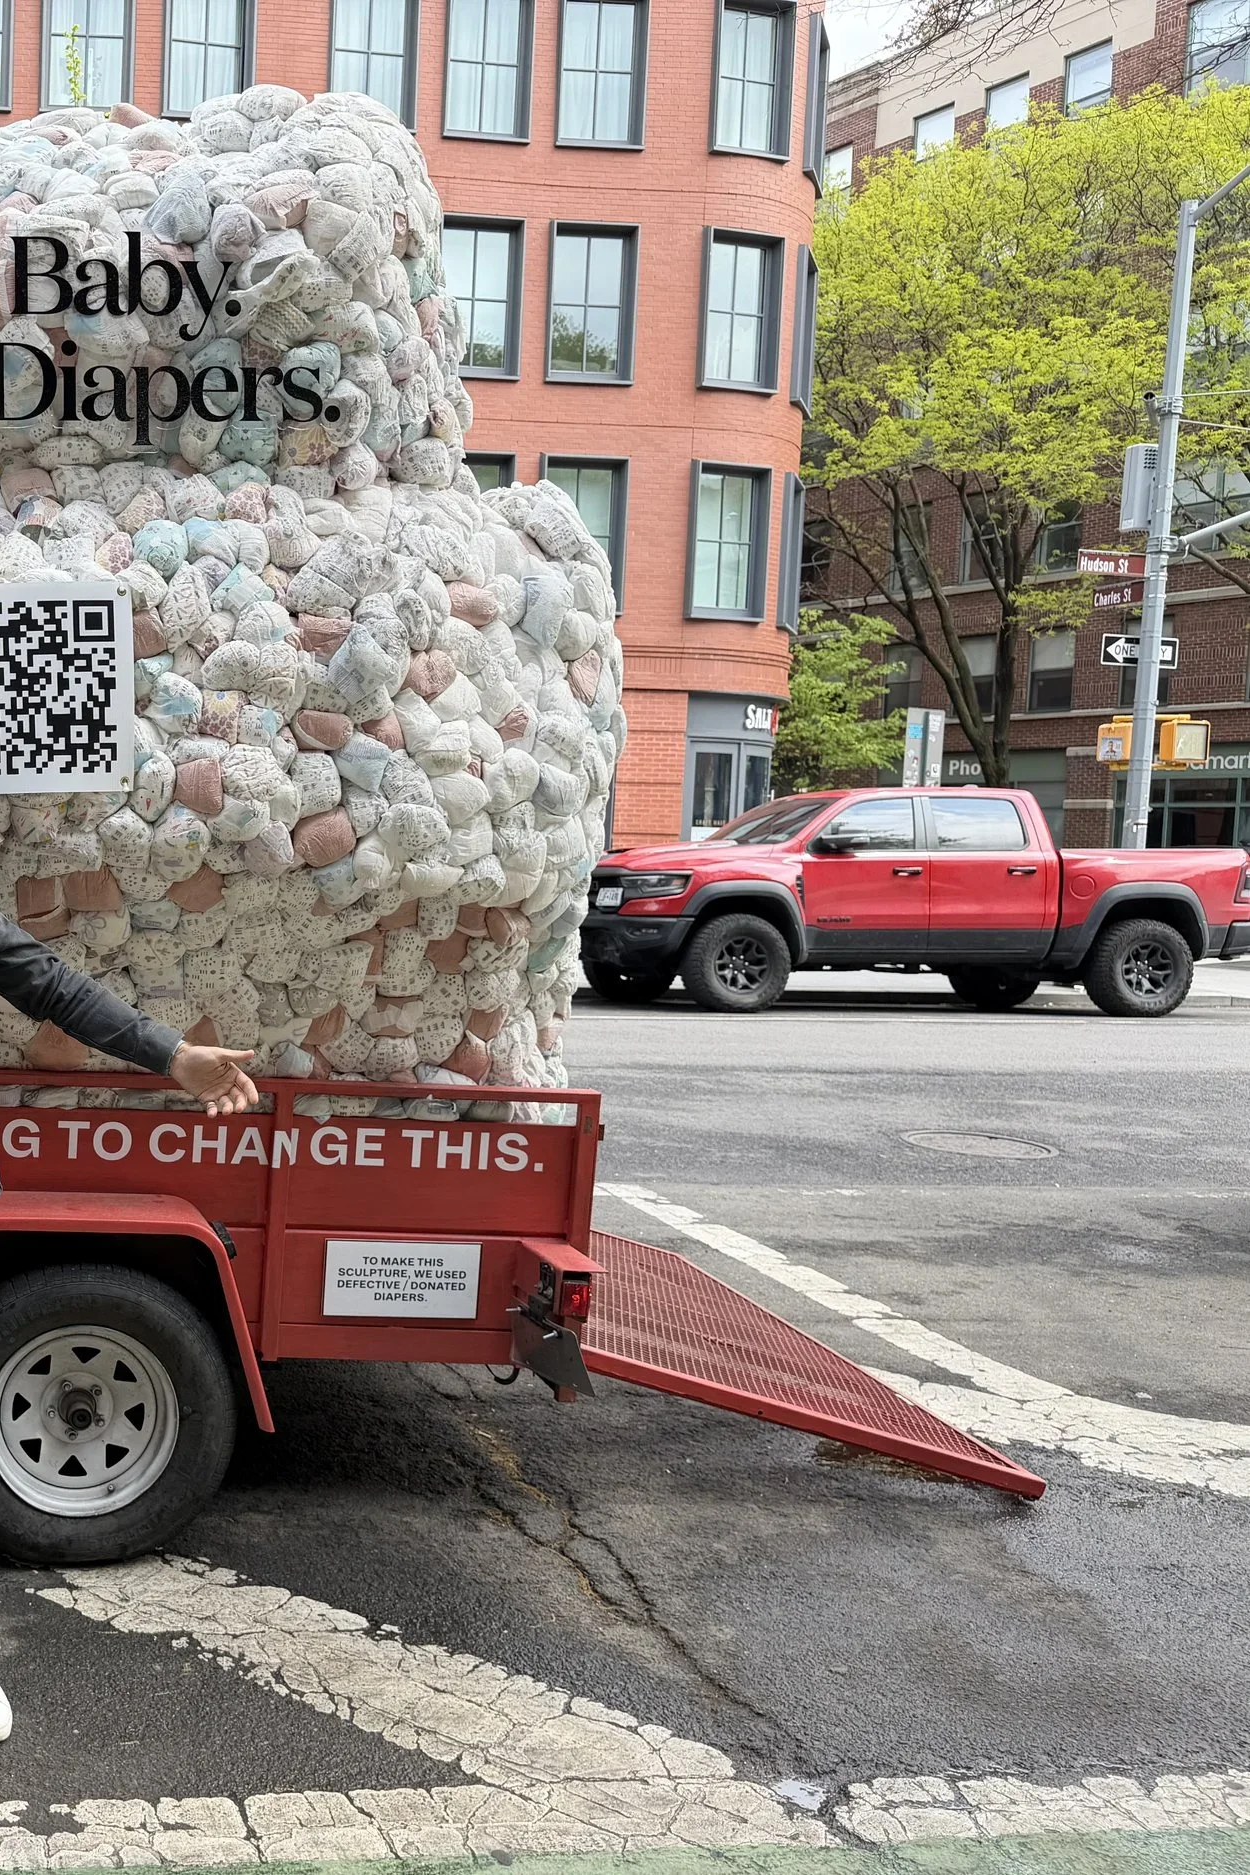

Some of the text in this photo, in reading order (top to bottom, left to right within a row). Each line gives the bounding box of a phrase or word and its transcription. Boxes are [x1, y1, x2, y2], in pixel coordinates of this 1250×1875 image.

[10, 230, 242, 341] Baby.
[1080, 556, 1129, 574] Hudson St
[1094, 588, 1132, 607] Charles St
[1114, 645, 1136, 657] ONE
[58, 1120, 133, 1162] TO
[149, 1122, 385, 1169] CHANGE
[401, 1129, 545, 1172] THIS.
[362, 1256, 444, 1267] TO MAKE THIS
[338, 1268, 467, 1279] SCULPTURE, WE USED
[337, 1279, 466, 1291] DEFECTIVE / DONATED
[373, 1292, 428, 1302] DIAPERS.
